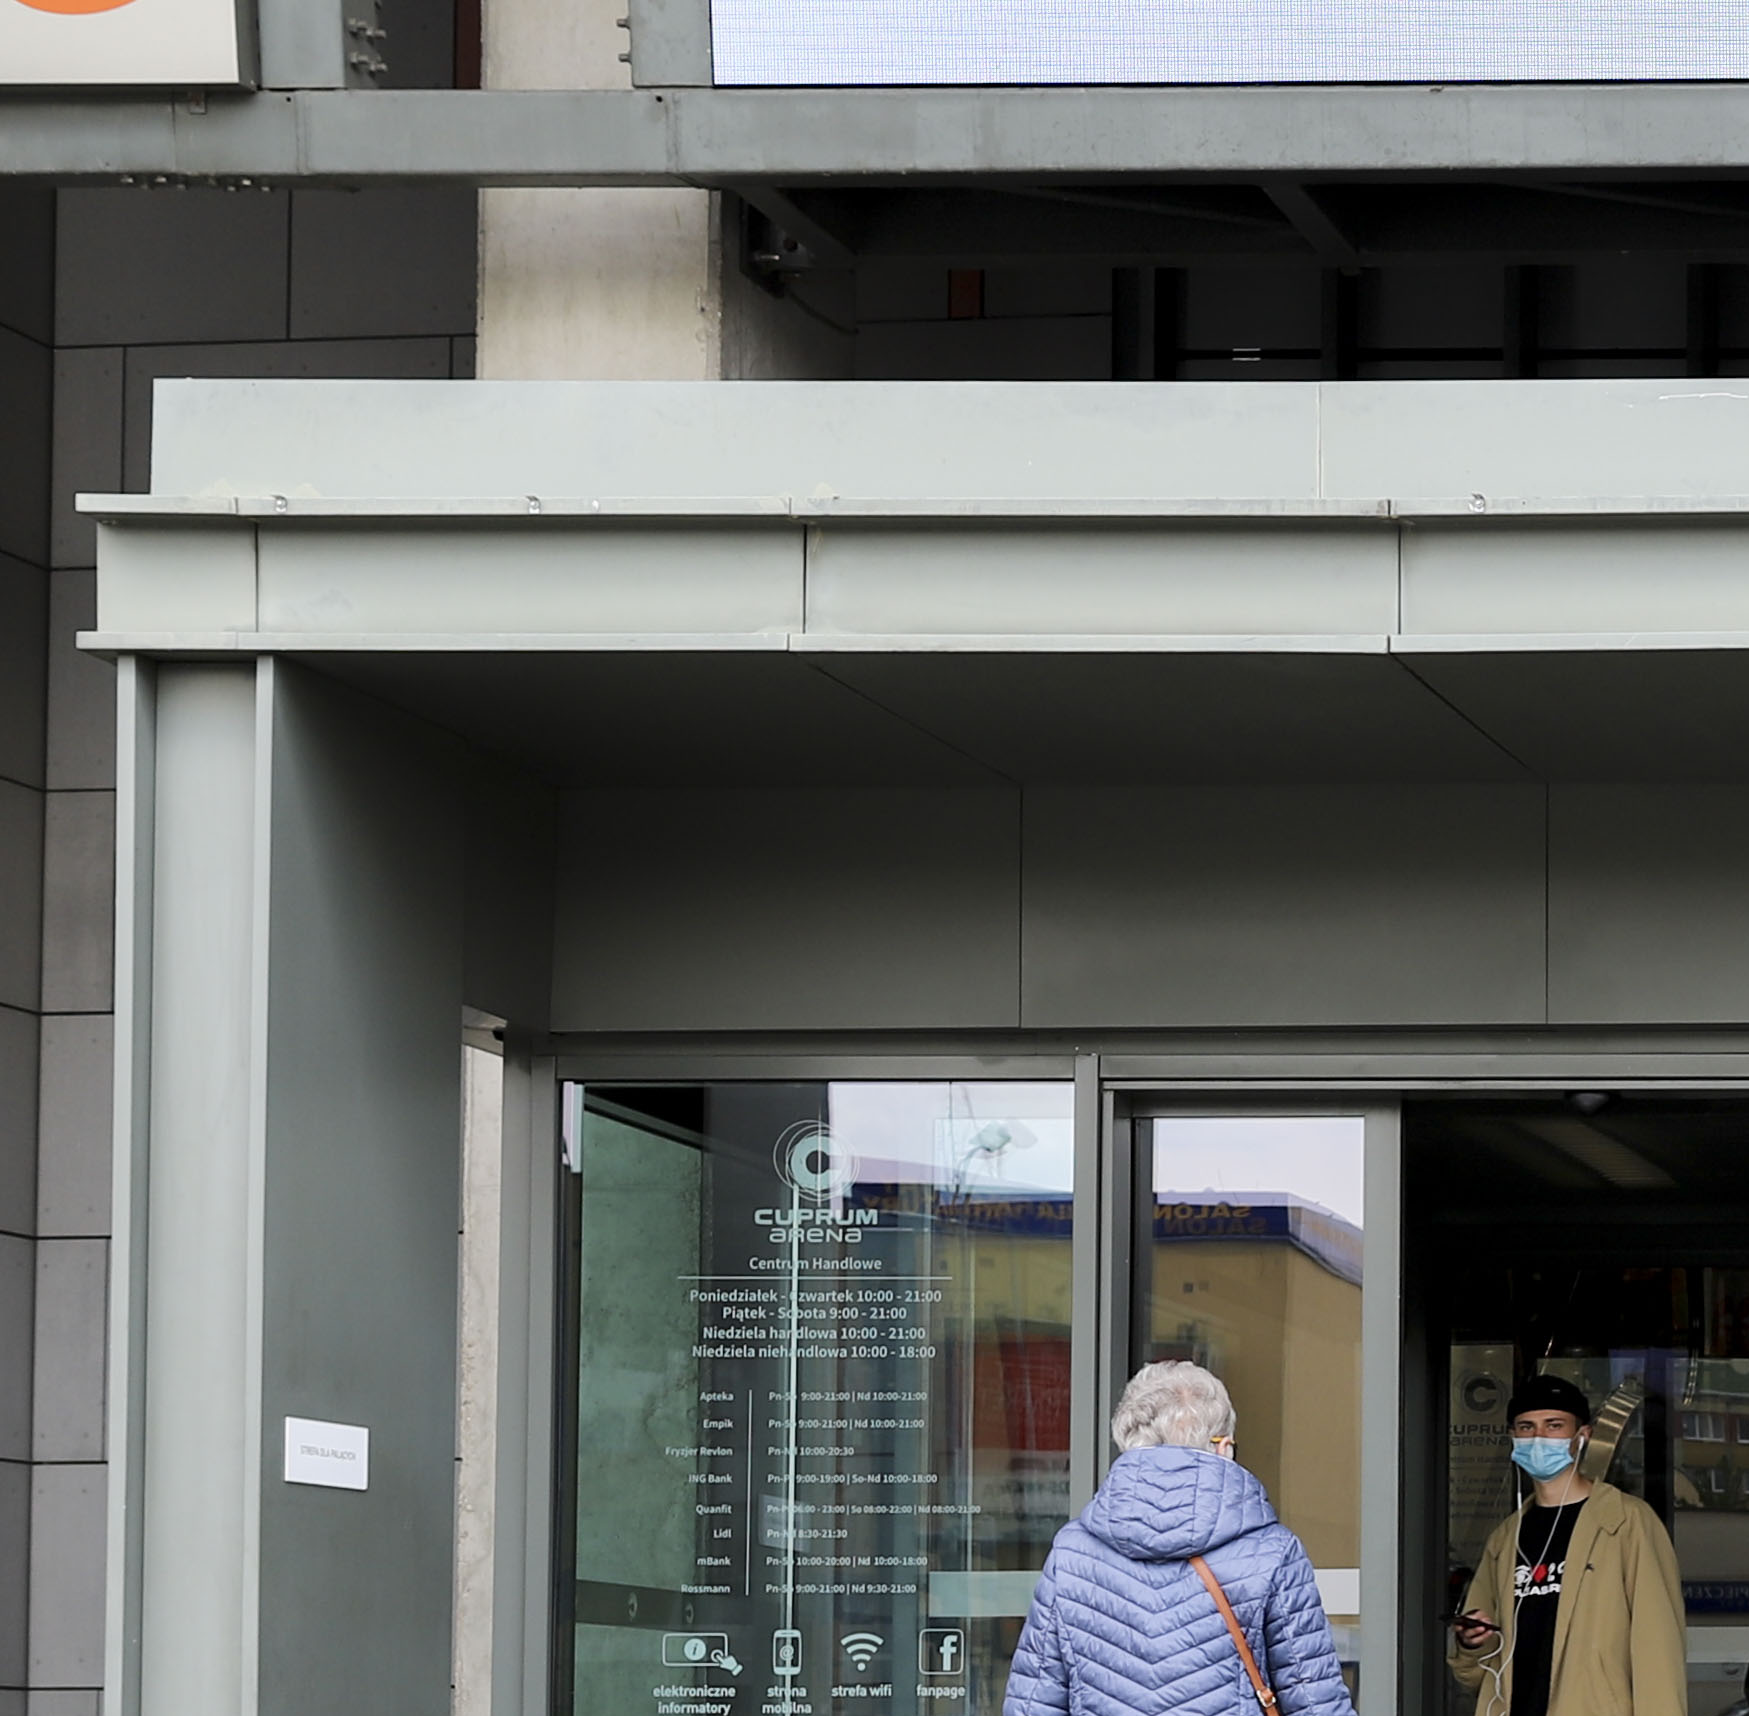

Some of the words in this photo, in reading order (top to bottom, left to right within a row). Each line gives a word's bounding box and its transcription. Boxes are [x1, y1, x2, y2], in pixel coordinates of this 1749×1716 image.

[753, 1208, 879, 1226] CUPRUM
[749, 1257, 809, 1270] Centrum
[812, 1257, 882, 1270] Handlowe
[690, 1289, 778, 1302] Poniedziałek
[856, 1289, 894, 1302] 10:00
[905, 1289, 942, 1302] 21:00
[722, 1306, 767, 1322] Piątek
[778, 1306, 826, 1319] Sobota
[829, 1306, 859, 1319] 9:00
[869, 1306, 907, 1319] 21:00
[703, 1327, 766, 1339] Niedziela
[769, 1327, 837, 1339] handlowa
[840, 1327, 878, 1339] 10:00
[888, 1327, 926, 1339] 21:00
[692, 1345, 755, 1358] Niedziela
[850, 1345, 888, 1358] 10:00
[899, 1345, 937, 1358] 18:00
[700, 1391, 734, 1403] Apteka
[768, 1391, 797, 1401] Pn-S
[857, 1391, 871, 1401] Nd
[873, 1391, 927, 1401] 10:00-21:00
[703, 1419, 733, 1430] Empik
[768, 1419, 797, 1428] Pn-S
[798, 1419, 848, 1428] 9:00-21:00
[854, 1419, 868, 1428] Nd
[870, 1419, 925, 1428] 10:00-21:00
[1450, 1424, 1513, 1435] UPRU
[665, 1446, 698, 1458] Fryzjer
[700, 1446, 733, 1456] Revlon
[800, 1446, 854, 1456] 10:00-20:30
[688, 1474, 706, 1483] ING
[708, 1474, 733, 1483] Bank
[767, 1474, 794, 1483] Pn-P
[796, 1474, 845, 1483] 9:00-19:00
[852, 1474, 881, 1483] So-Nd
[883, 1474, 937, 1483] 10:00-18:00
[695, 1504, 732, 1516] Quanfit
[767, 1505, 793, 1514] Pn-P
[918, 1505, 930, 1514] Nd
[713, 1529, 732, 1538] Lidl
[697, 1556, 731, 1566] mBank
[766, 1557, 794, 1566] Pn-S
[796, 1557, 850, 1566] 10:00-20:00
[858, 1557, 870, 1566] Nd
[874, 1557, 928, 1566] 10:00-18:00
[681, 1584, 731, 1593] Rossmann
[766, 1584, 794, 1594] Pn-S
[796, 1584, 845, 1594] 9:00-21:00
[852, 1584, 865, 1594] Nd
[867, 1584, 916, 1594] 9:30-21:00
[653, 1684, 736, 1697] elektroniczne
[767, 1686, 807, 1697] strona
[831, 1684, 868, 1697] strefa
[869, 1684, 892, 1697] wifi
[916, 1684, 966, 1699] fanpage
[658, 1701, 731, 1715] informatory
[762, 1701, 812, 1714] mobilna
